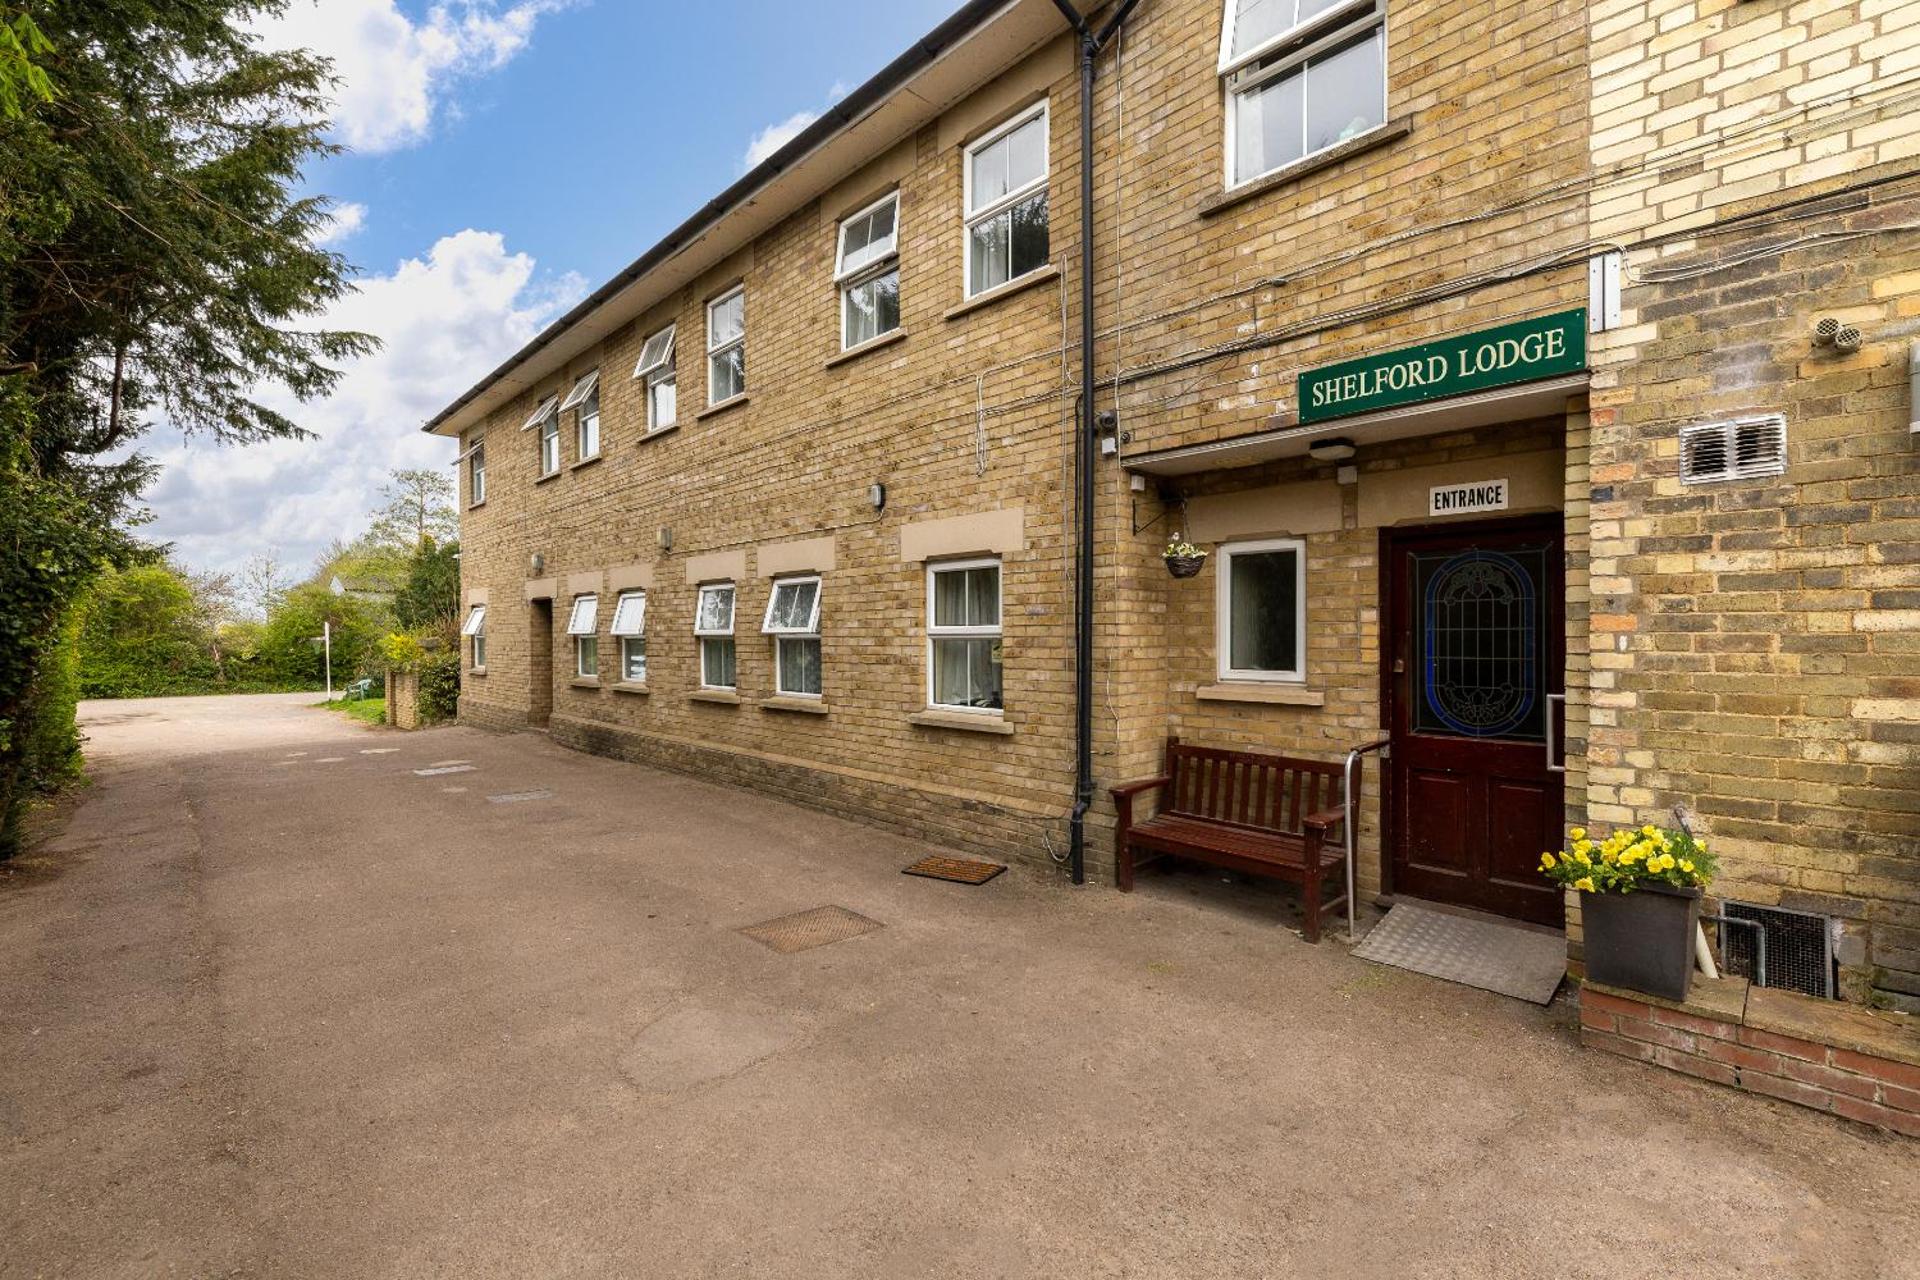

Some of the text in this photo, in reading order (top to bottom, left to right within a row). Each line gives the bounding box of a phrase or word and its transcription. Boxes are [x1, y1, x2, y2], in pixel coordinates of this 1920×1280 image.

[1312, 327, 1566, 407] SHELFORD LODGE
[1434, 485, 1503, 510] ENTRANCE
